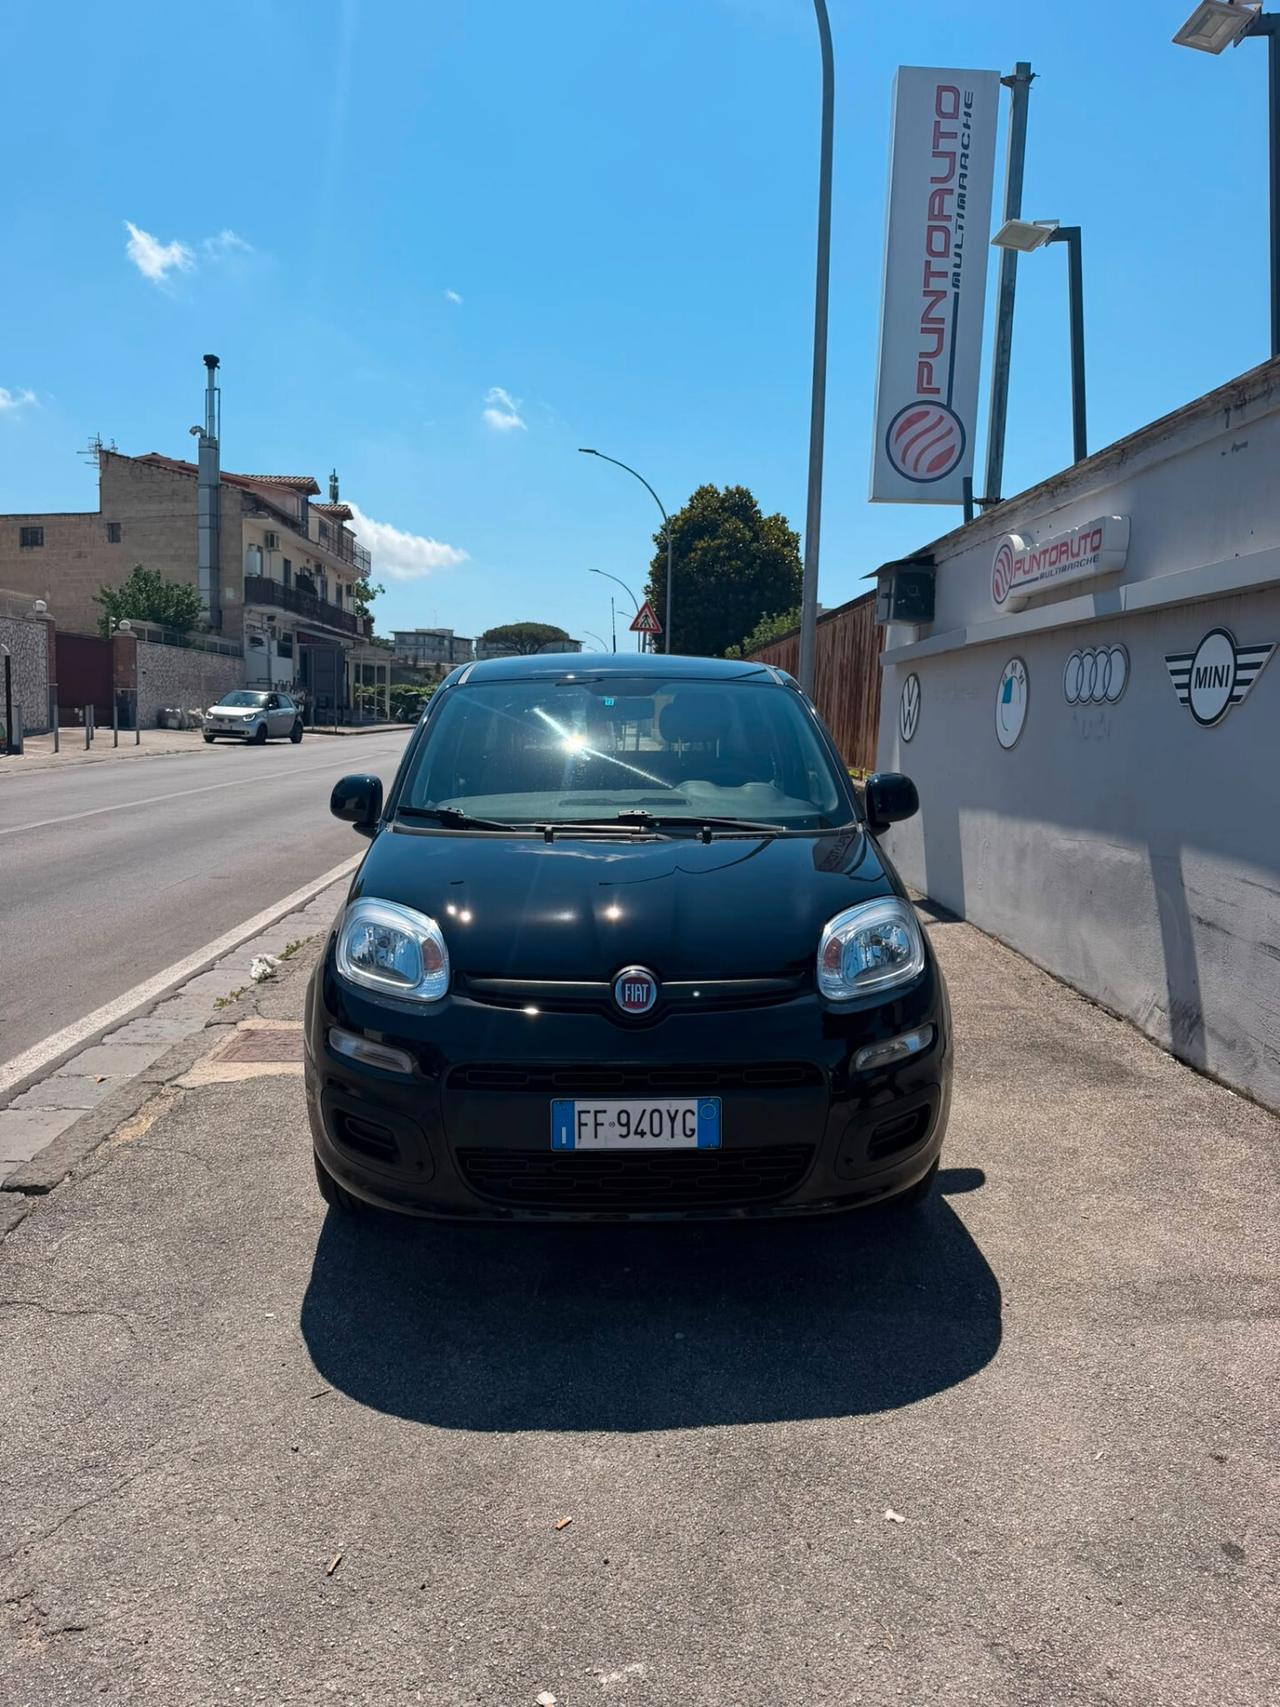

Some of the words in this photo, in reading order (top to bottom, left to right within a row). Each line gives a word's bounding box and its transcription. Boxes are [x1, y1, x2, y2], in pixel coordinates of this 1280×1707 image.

[952, 90, 974, 289] MULTIMARCHE
[917, 85, 960, 394] PUNTOAUTO
[1014, 528, 1102, 578] PUNTOAUTO
[1194, 665, 1230, 689] MINI
[625, 984, 648, 1002] FIAT
